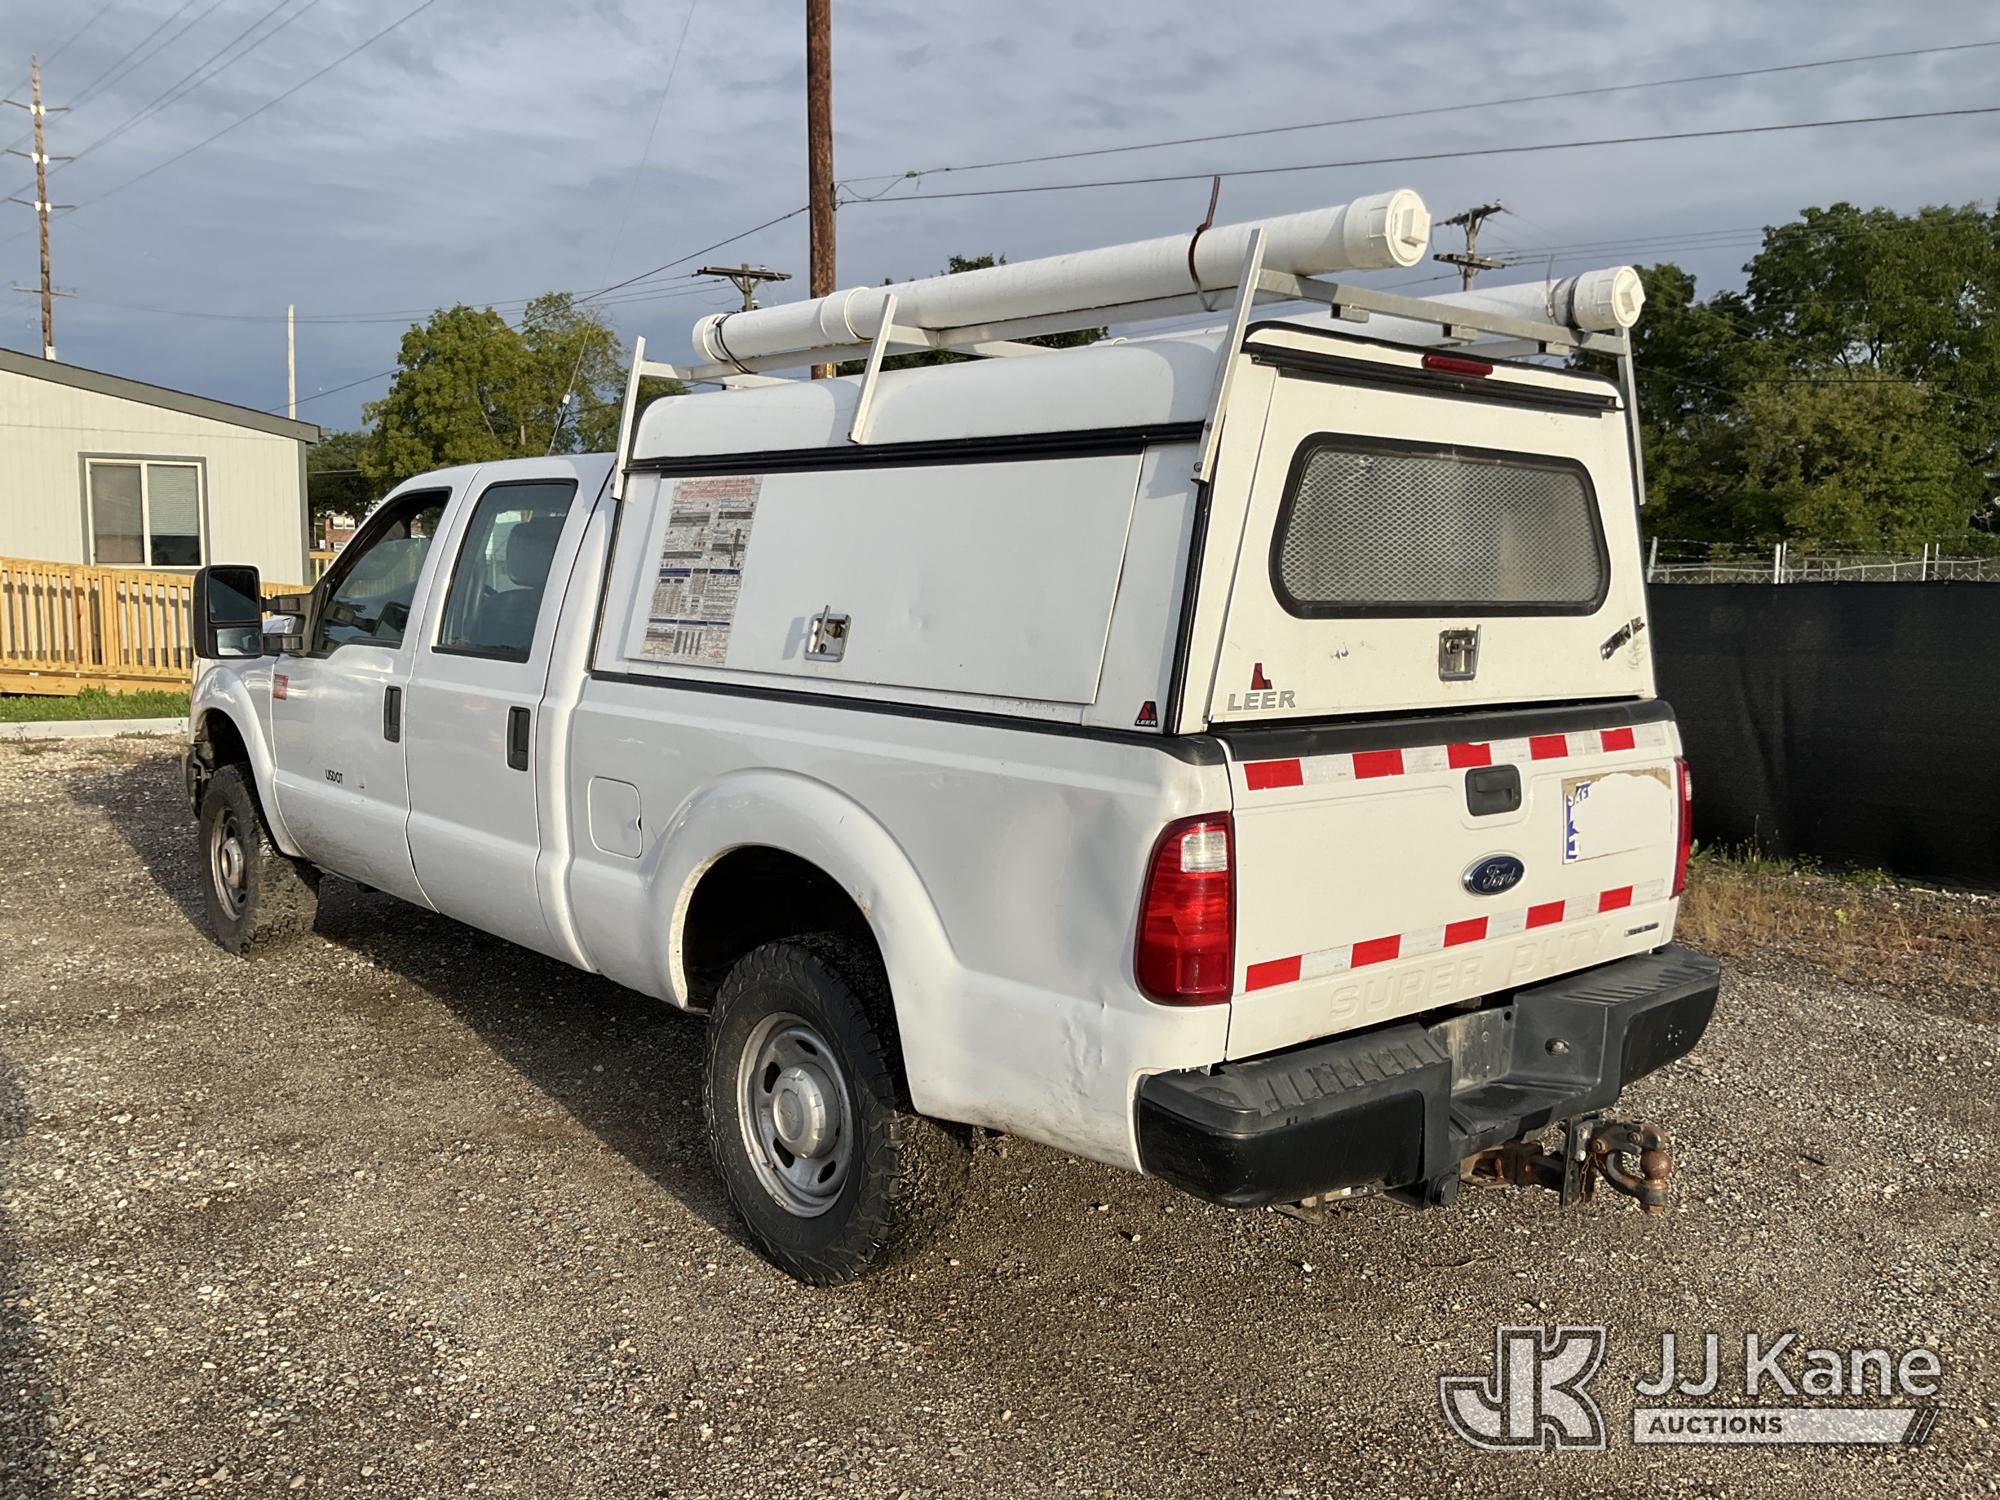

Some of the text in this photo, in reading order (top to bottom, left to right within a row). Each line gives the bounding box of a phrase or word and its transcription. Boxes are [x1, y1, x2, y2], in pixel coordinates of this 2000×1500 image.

[1227, 690, 1296, 711] LEER
[325, 768, 343, 784] USDOT
[1483, 863, 1517, 889] Ford
[1329, 922, 1610, 1020] SUPER DUTY
